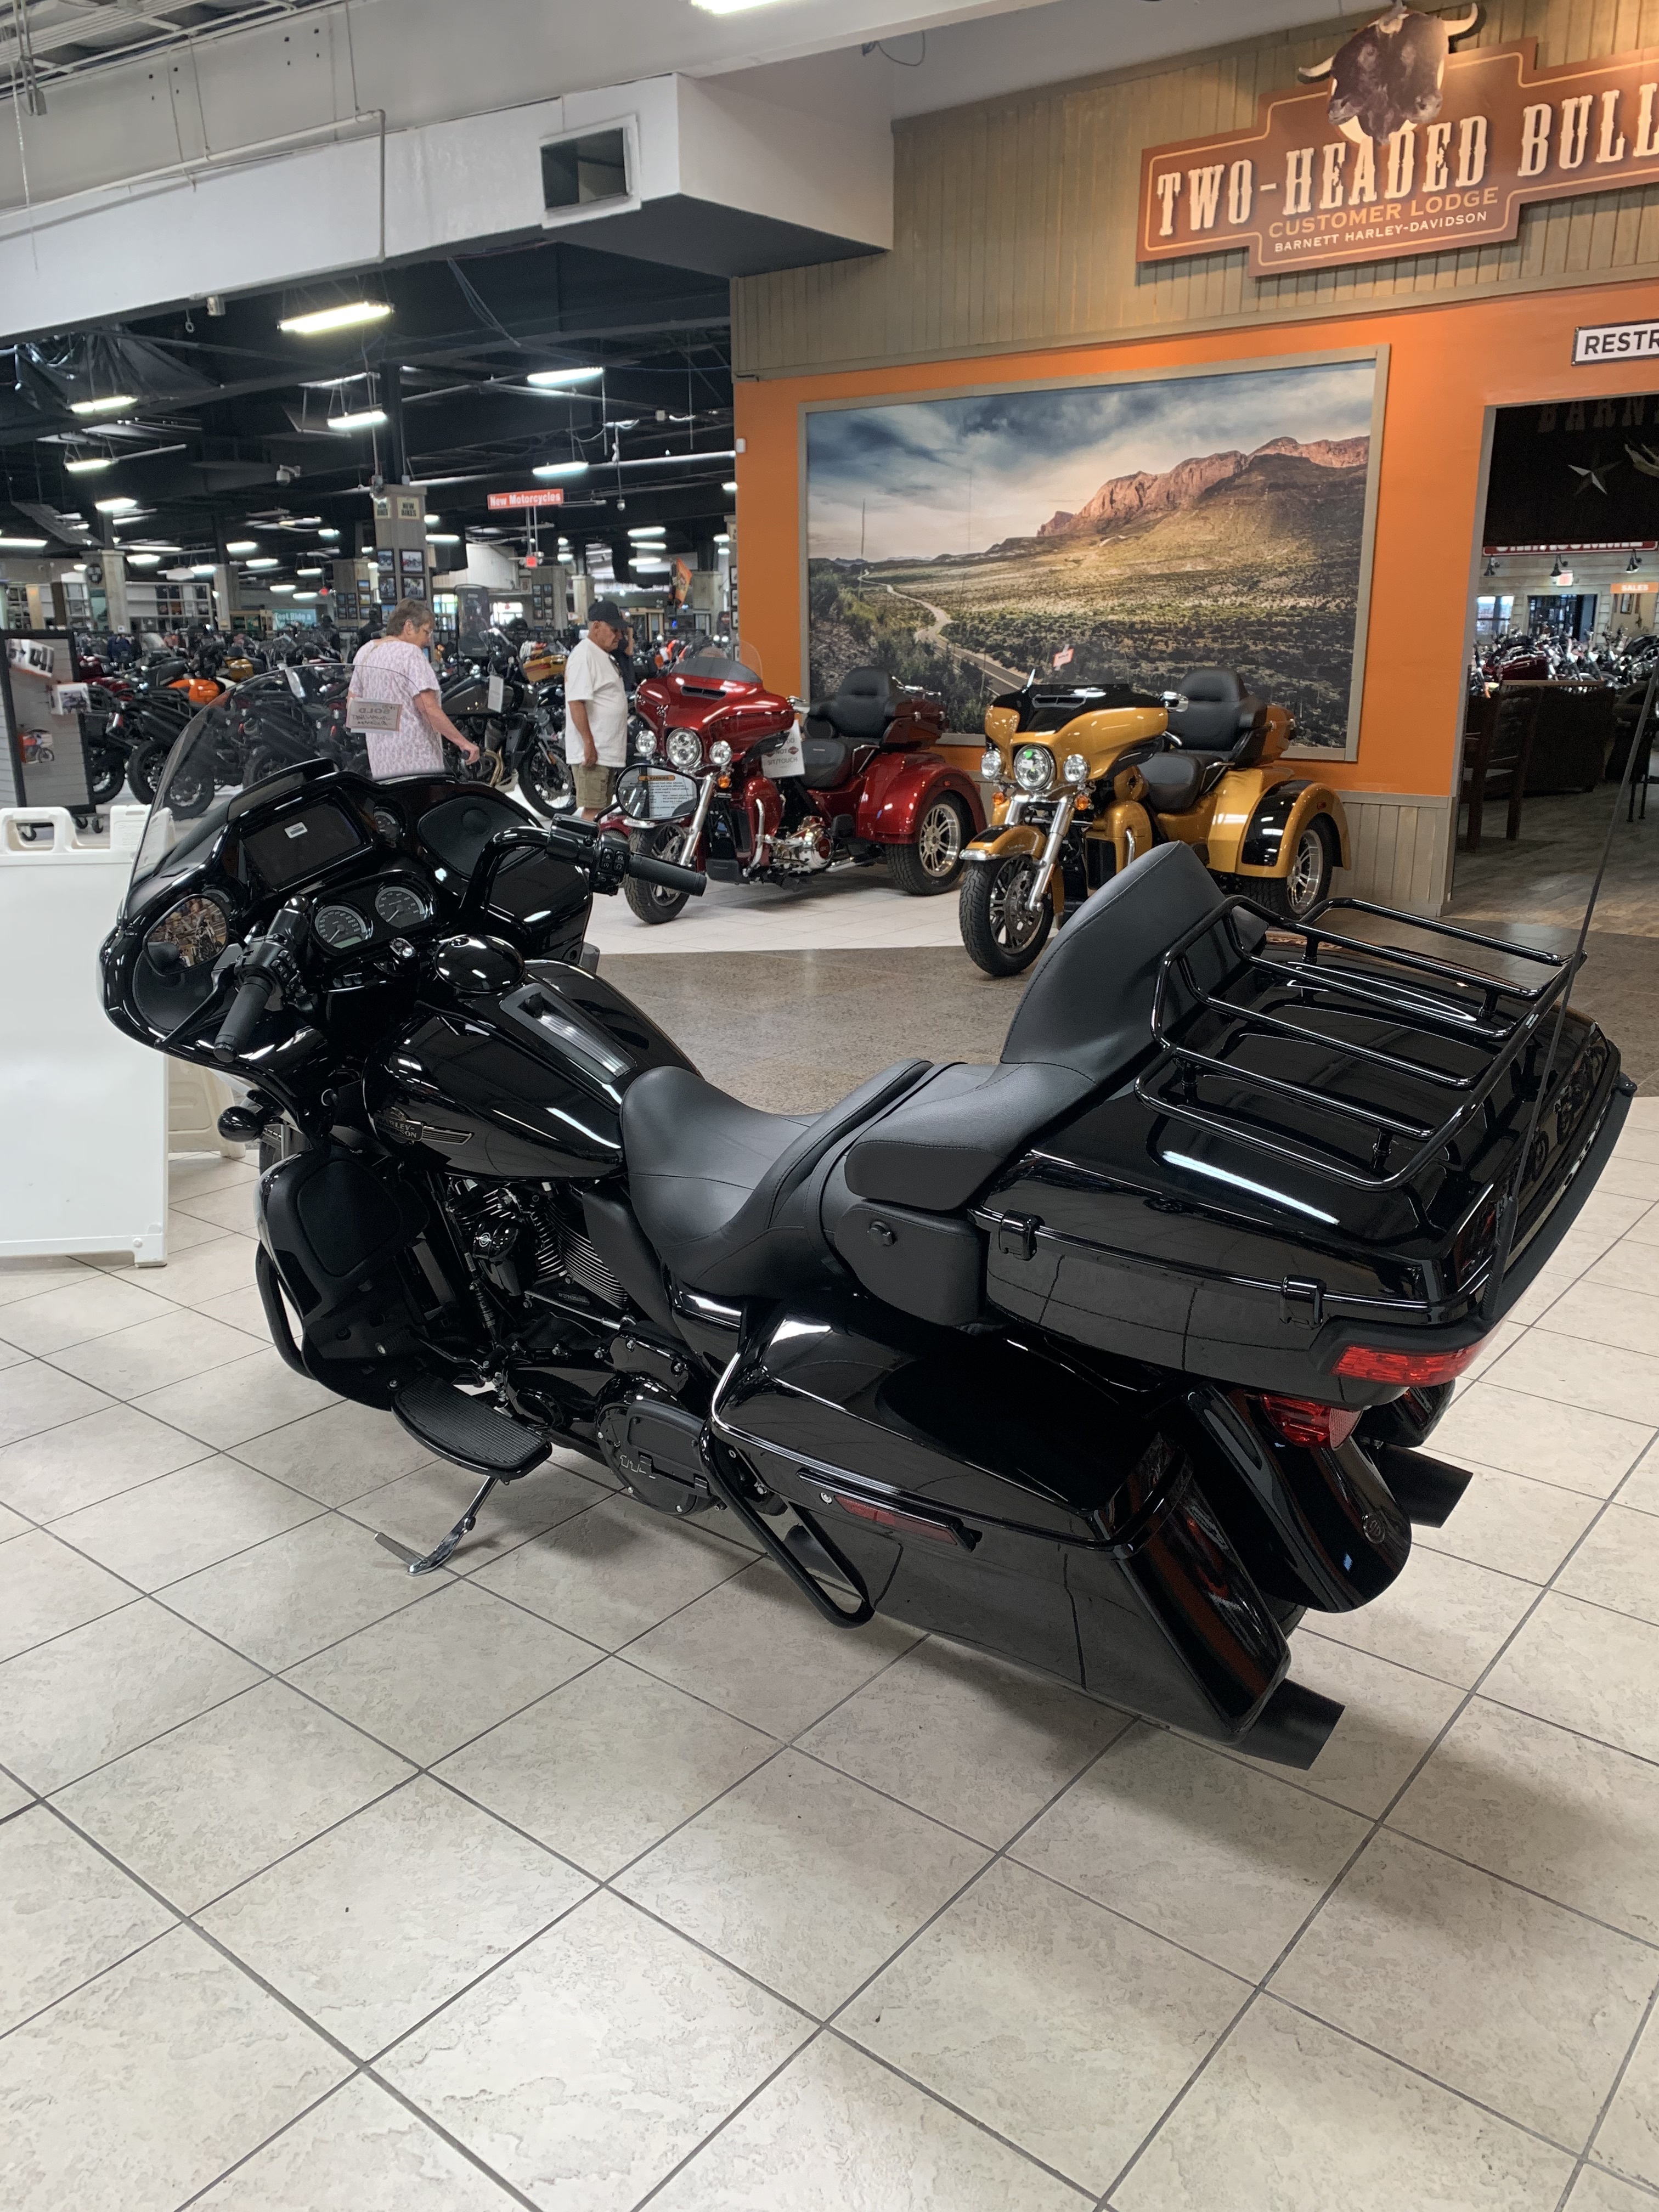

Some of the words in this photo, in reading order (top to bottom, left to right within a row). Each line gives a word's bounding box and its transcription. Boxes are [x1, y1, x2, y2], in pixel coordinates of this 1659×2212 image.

[1157, 115, 1488, 236] TWO-HEADED
[1517, 82, 1659, 177] BULL
[1268, 204, 1402, 238] CUSTOMER
[1410, 187, 1499, 217] LODGE
[1274, 234, 1340, 253] BARNETT
[1345, 211, 1487, 242] HARLEY-DAVIDSON
[490, 495, 507, 506] New
[509, 491, 561, 505] Motorcycles
